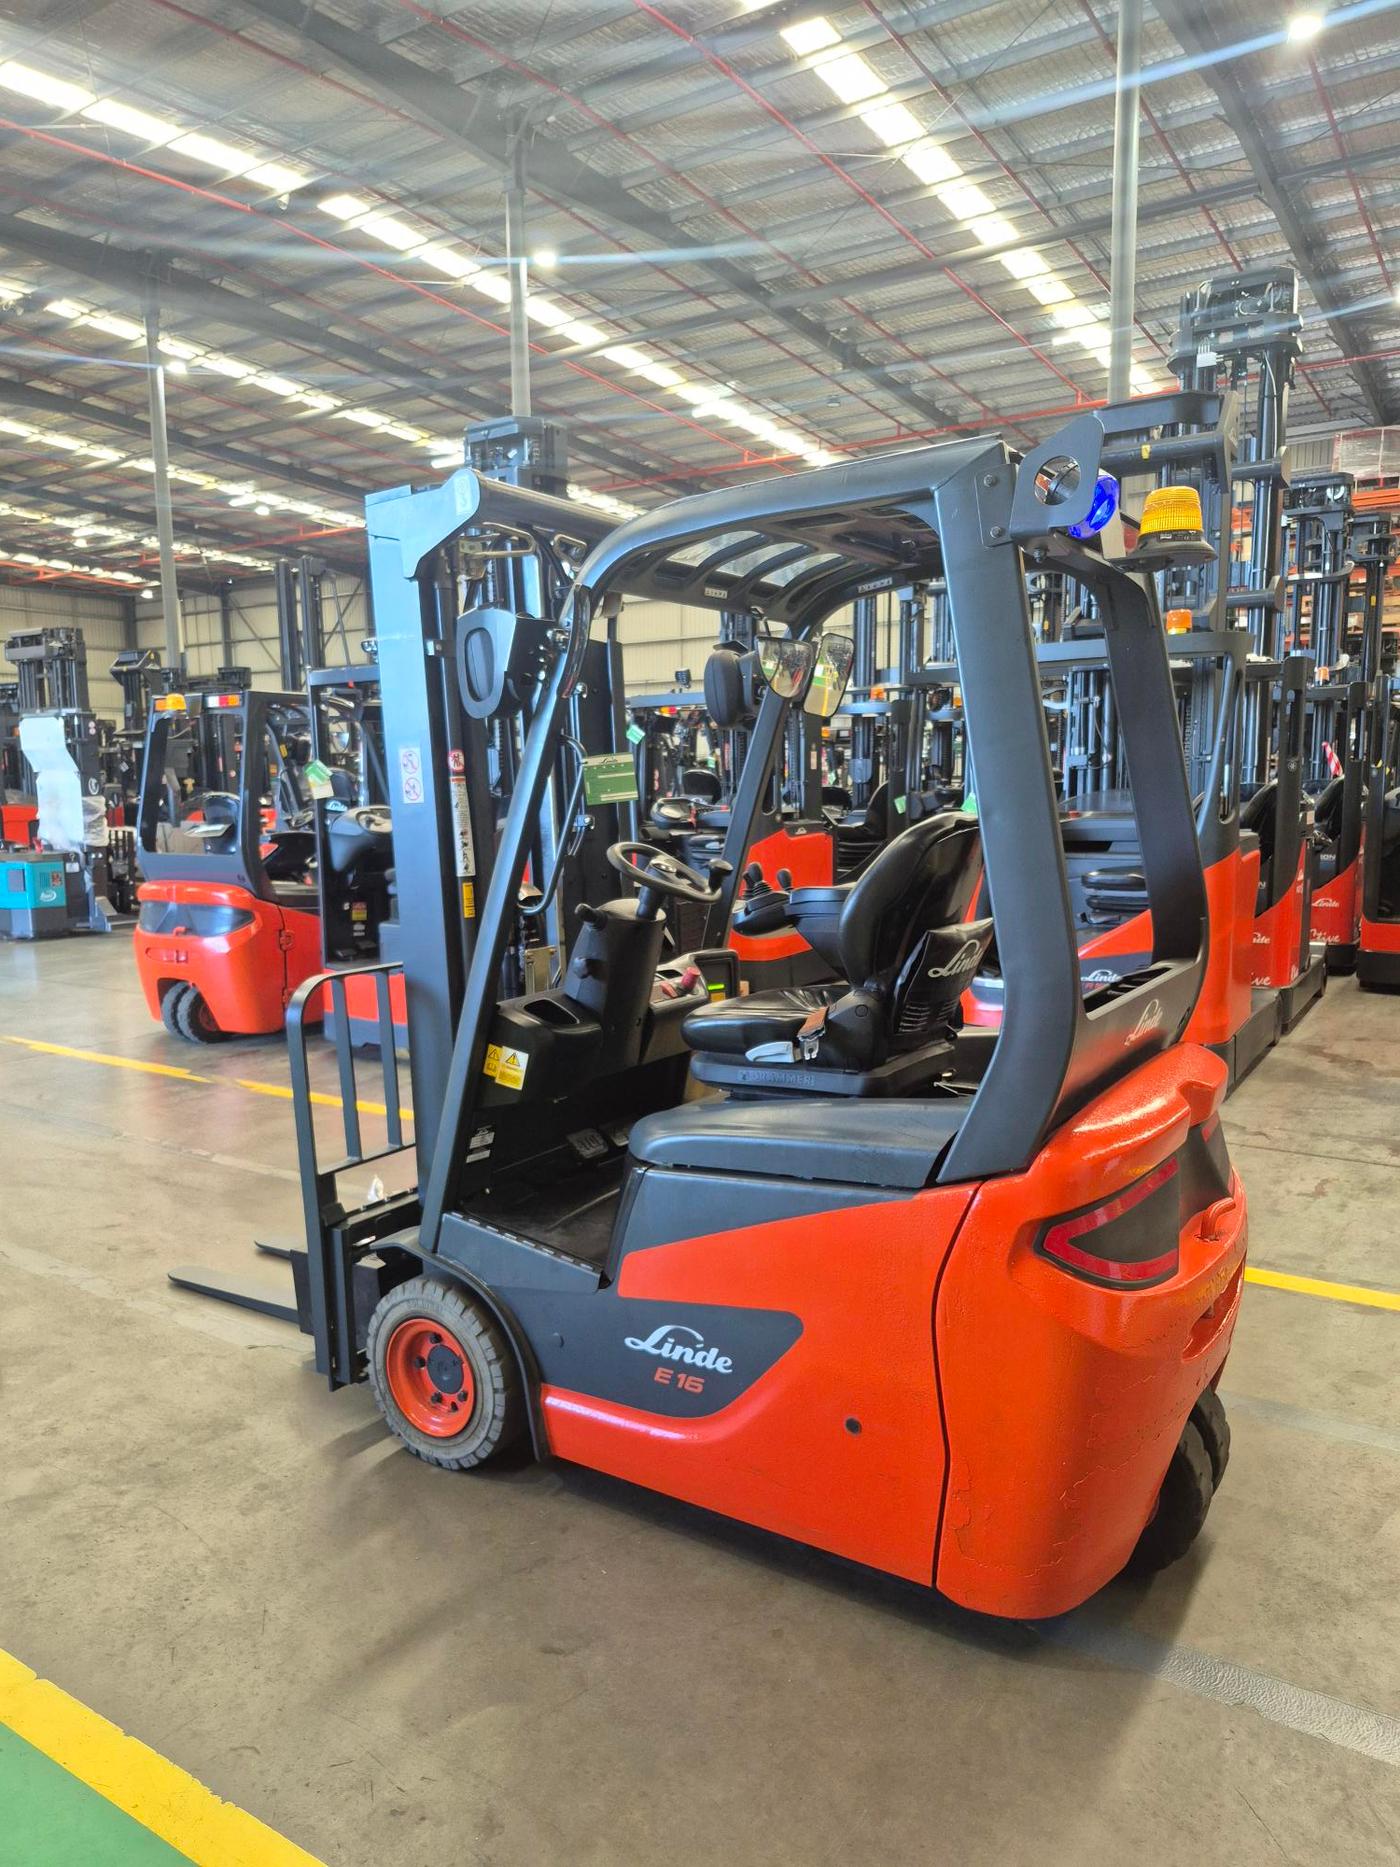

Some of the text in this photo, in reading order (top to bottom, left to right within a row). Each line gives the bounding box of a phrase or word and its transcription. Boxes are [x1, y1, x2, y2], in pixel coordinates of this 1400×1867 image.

[623, 1324, 734, 1375] Linde
[653, 1366, 706, 1394] E 16
